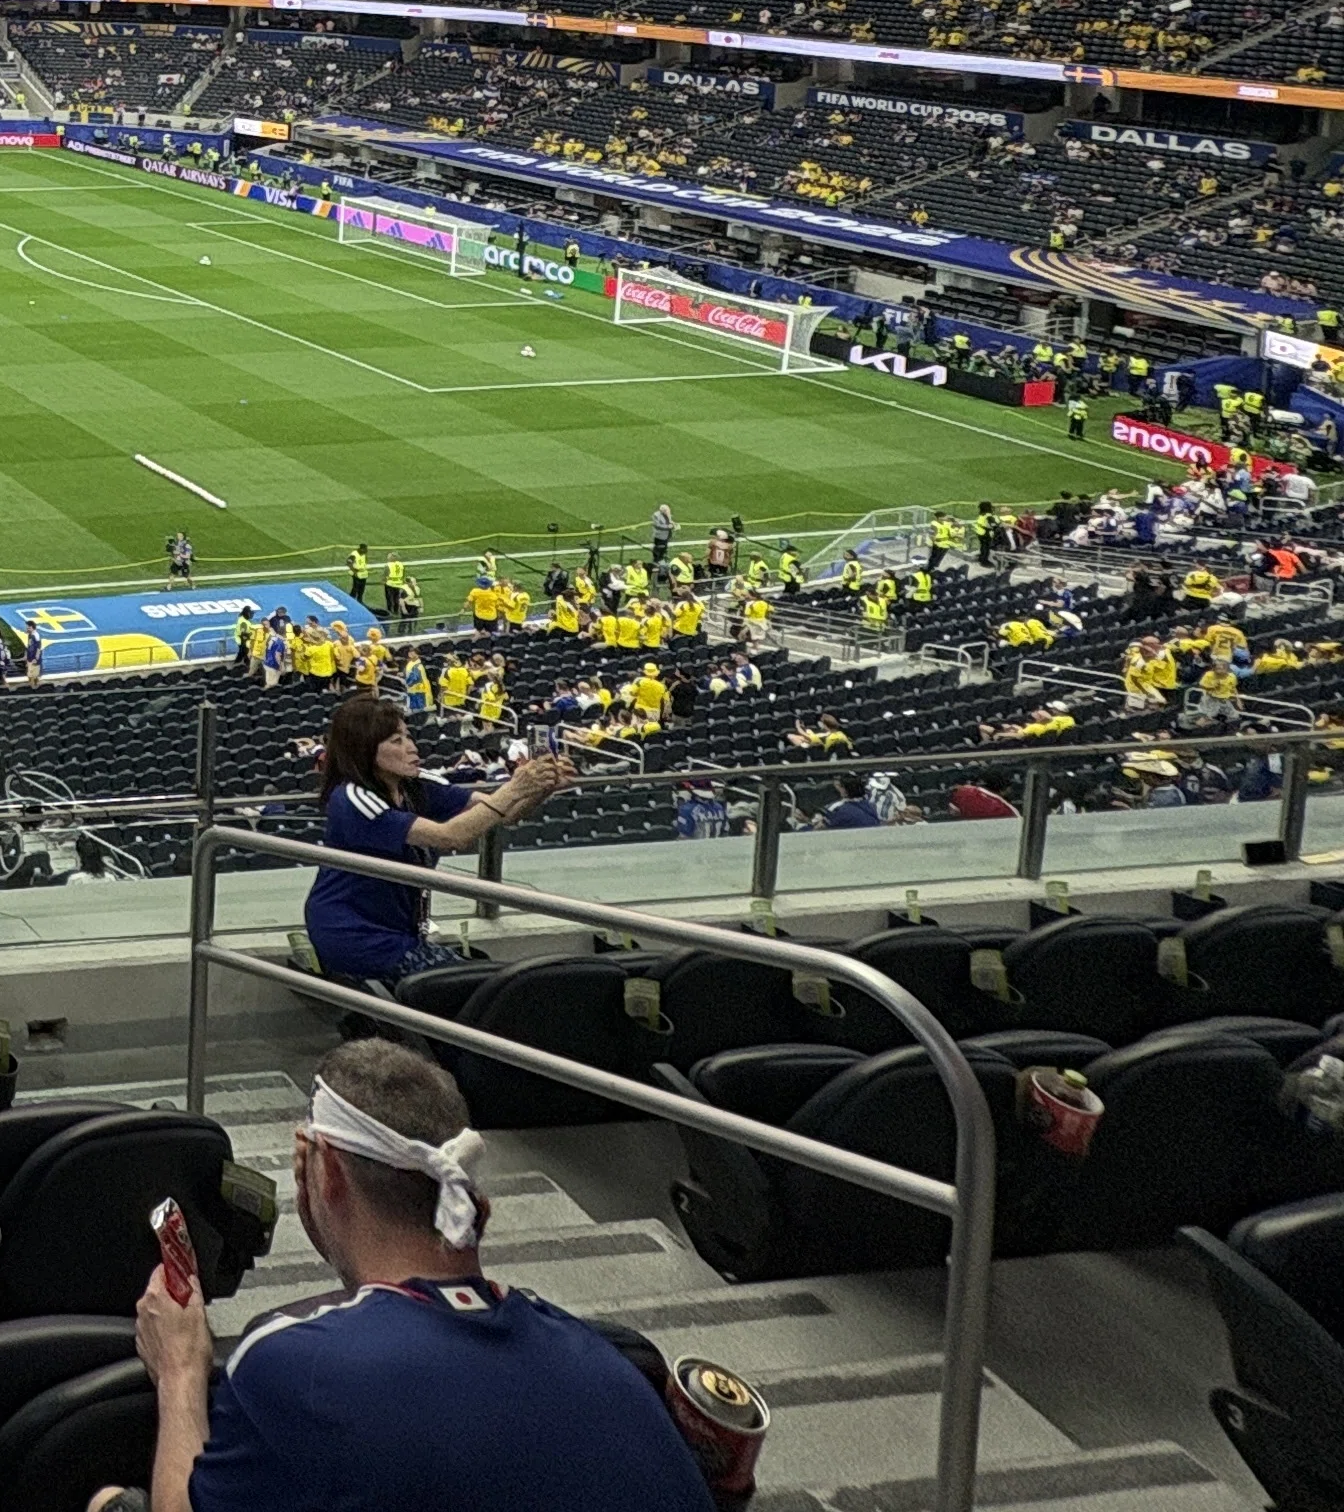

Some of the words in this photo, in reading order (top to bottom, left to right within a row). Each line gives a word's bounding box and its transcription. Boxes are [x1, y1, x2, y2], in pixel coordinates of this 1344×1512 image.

[817, 91, 850, 108] FIFA
[851, 95, 909, 114] WORLD
[910, 102, 944, 118] CUP
[946, 106, 1008, 127] 2026
[1091, 125, 1253, 160] DALLAS
[141, 157, 178, 178] QATAR
[179, 166, 227, 190] AIRWAYS
[332, 174, 354, 189] FIFA
[460, 146, 539, 167] FIFA
[535, 160, 678, 194] WORLD
[672, 188, 772, 212] CUP
[758, 206, 950, 248] 2026
[484, 244, 574, 285] aramco
[620, 282, 672, 313] Coca-Cola
[708, 306, 767, 338] Coca-Cola
[849, 344, 948, 386] KIA
[140, 597, 263, 619] SWEDEN
